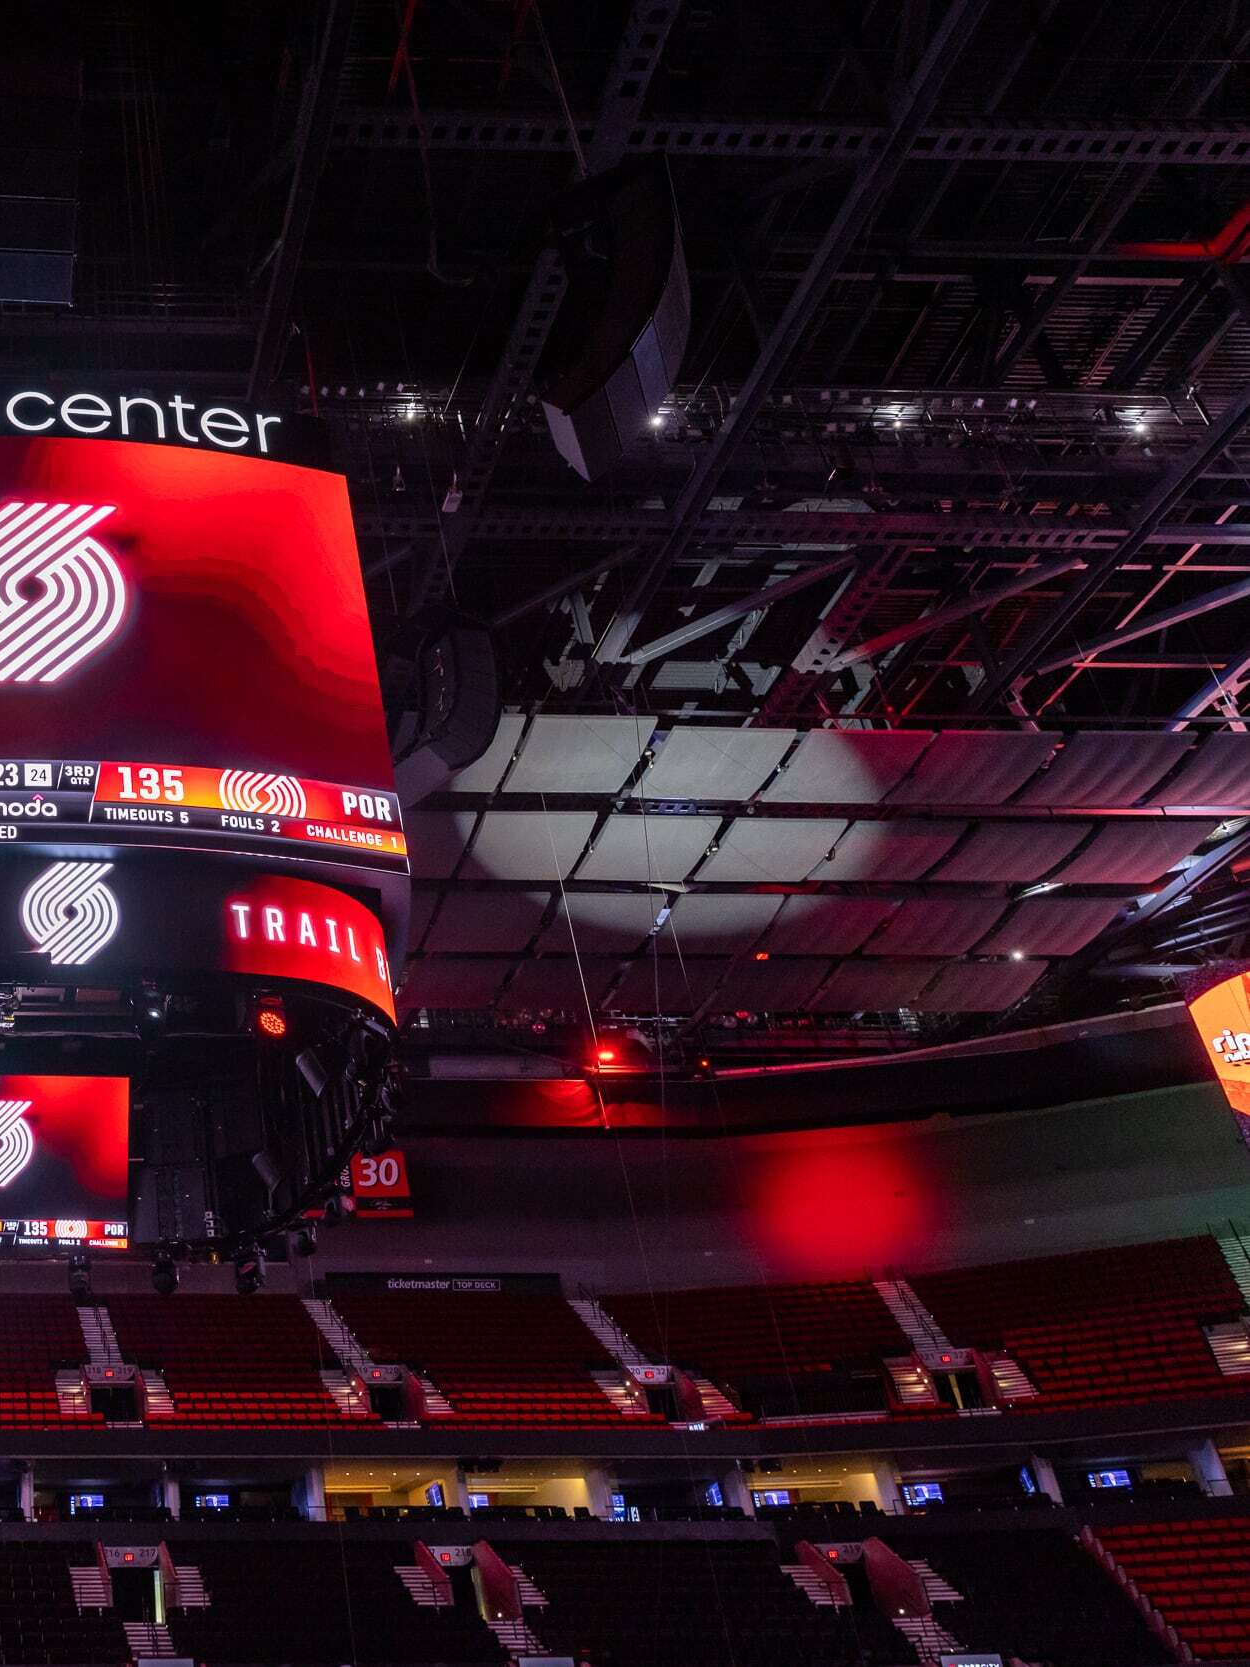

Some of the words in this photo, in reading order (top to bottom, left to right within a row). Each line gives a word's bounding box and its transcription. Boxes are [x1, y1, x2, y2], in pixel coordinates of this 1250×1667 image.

[30, 769, 47, 782] 24
[65, 766, 94, 777] 3RD
[70, 777, 90, 785] QTR
[118, 766, 184, 802] 135
[341, 791, 392, 822] POR
[104, 807, 174, 823] TIMEOUTS
[180, 812, 189, 824] 5
[221, 815, 264, 830] FOULS
[271, 820, 281, 833] 2
[306, 824, 382, 846] CHALLENGE
[391, 837, 397, 849] 1
[230, 904, 361, 963] TRAIL
[358, 1158, 398, 1186] 30
[24, 1221, 48, 1235] 135
[104, 1224, 124, 1235] POR
[388, 1279, 450, 1290] ticketmaster
